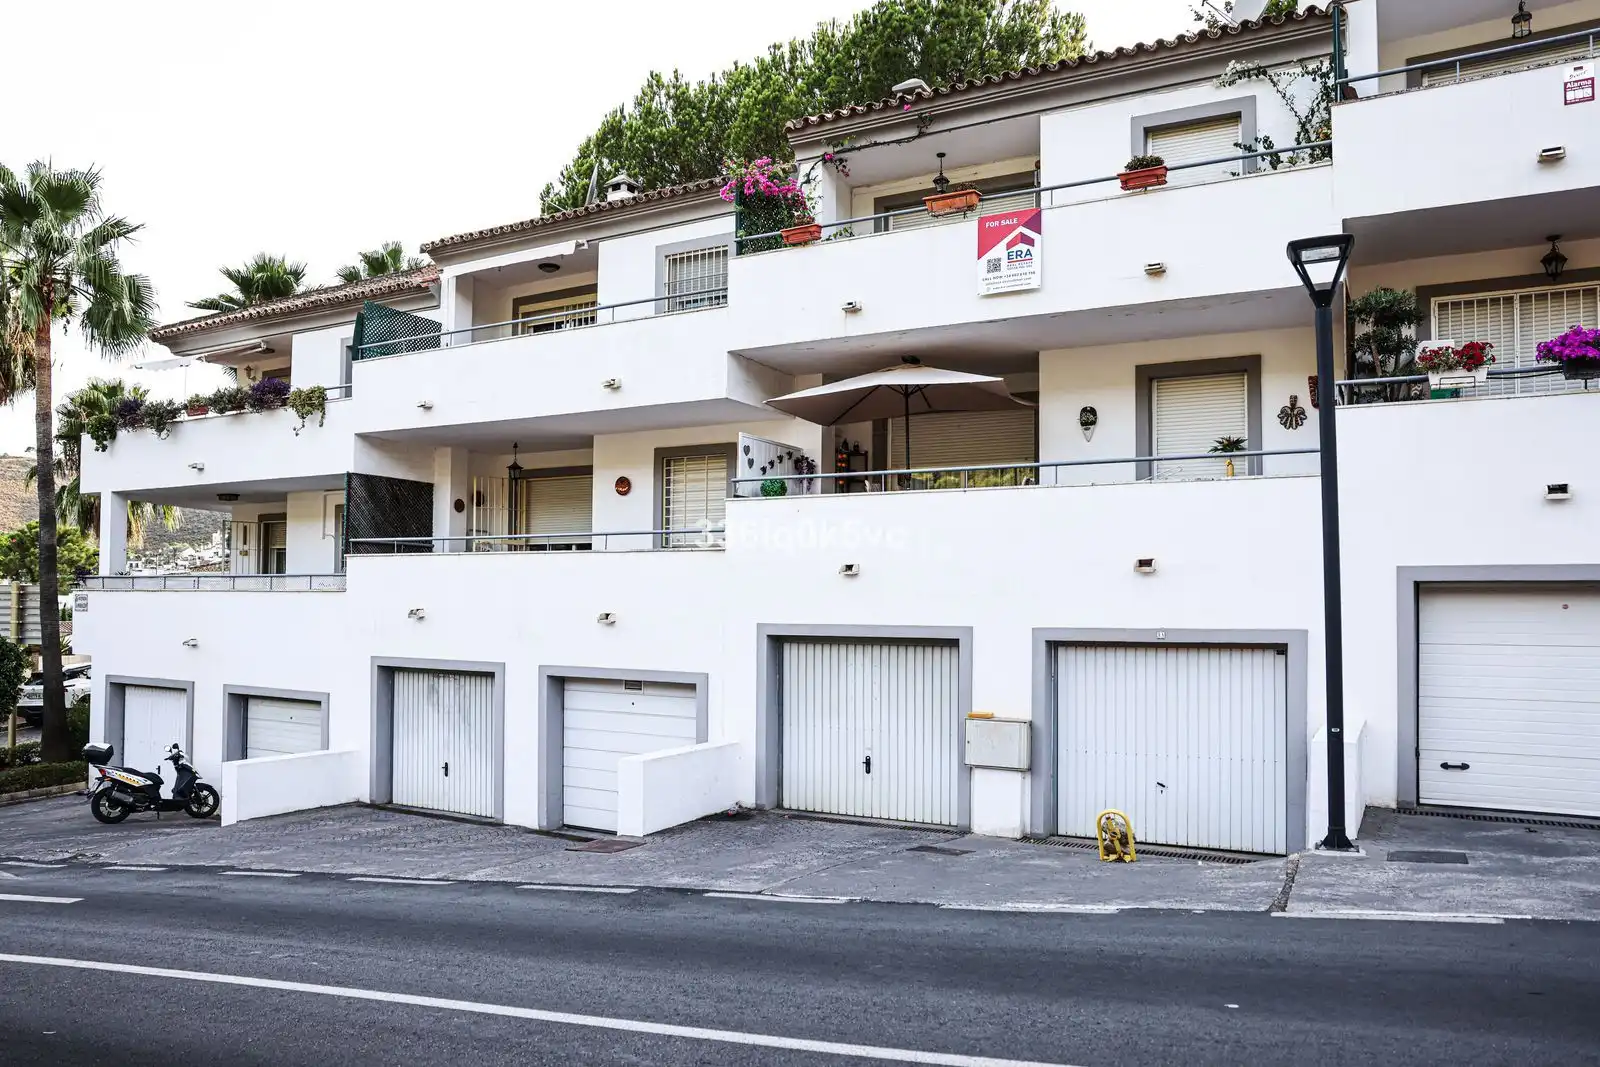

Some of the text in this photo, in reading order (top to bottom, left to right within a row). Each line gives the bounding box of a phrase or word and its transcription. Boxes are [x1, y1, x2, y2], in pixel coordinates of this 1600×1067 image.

[1566, 80, 1592, 89] Alarma
[985, 218, 1018, 228] FOR SALE
[1007, 249, 1033, 260] ERA
